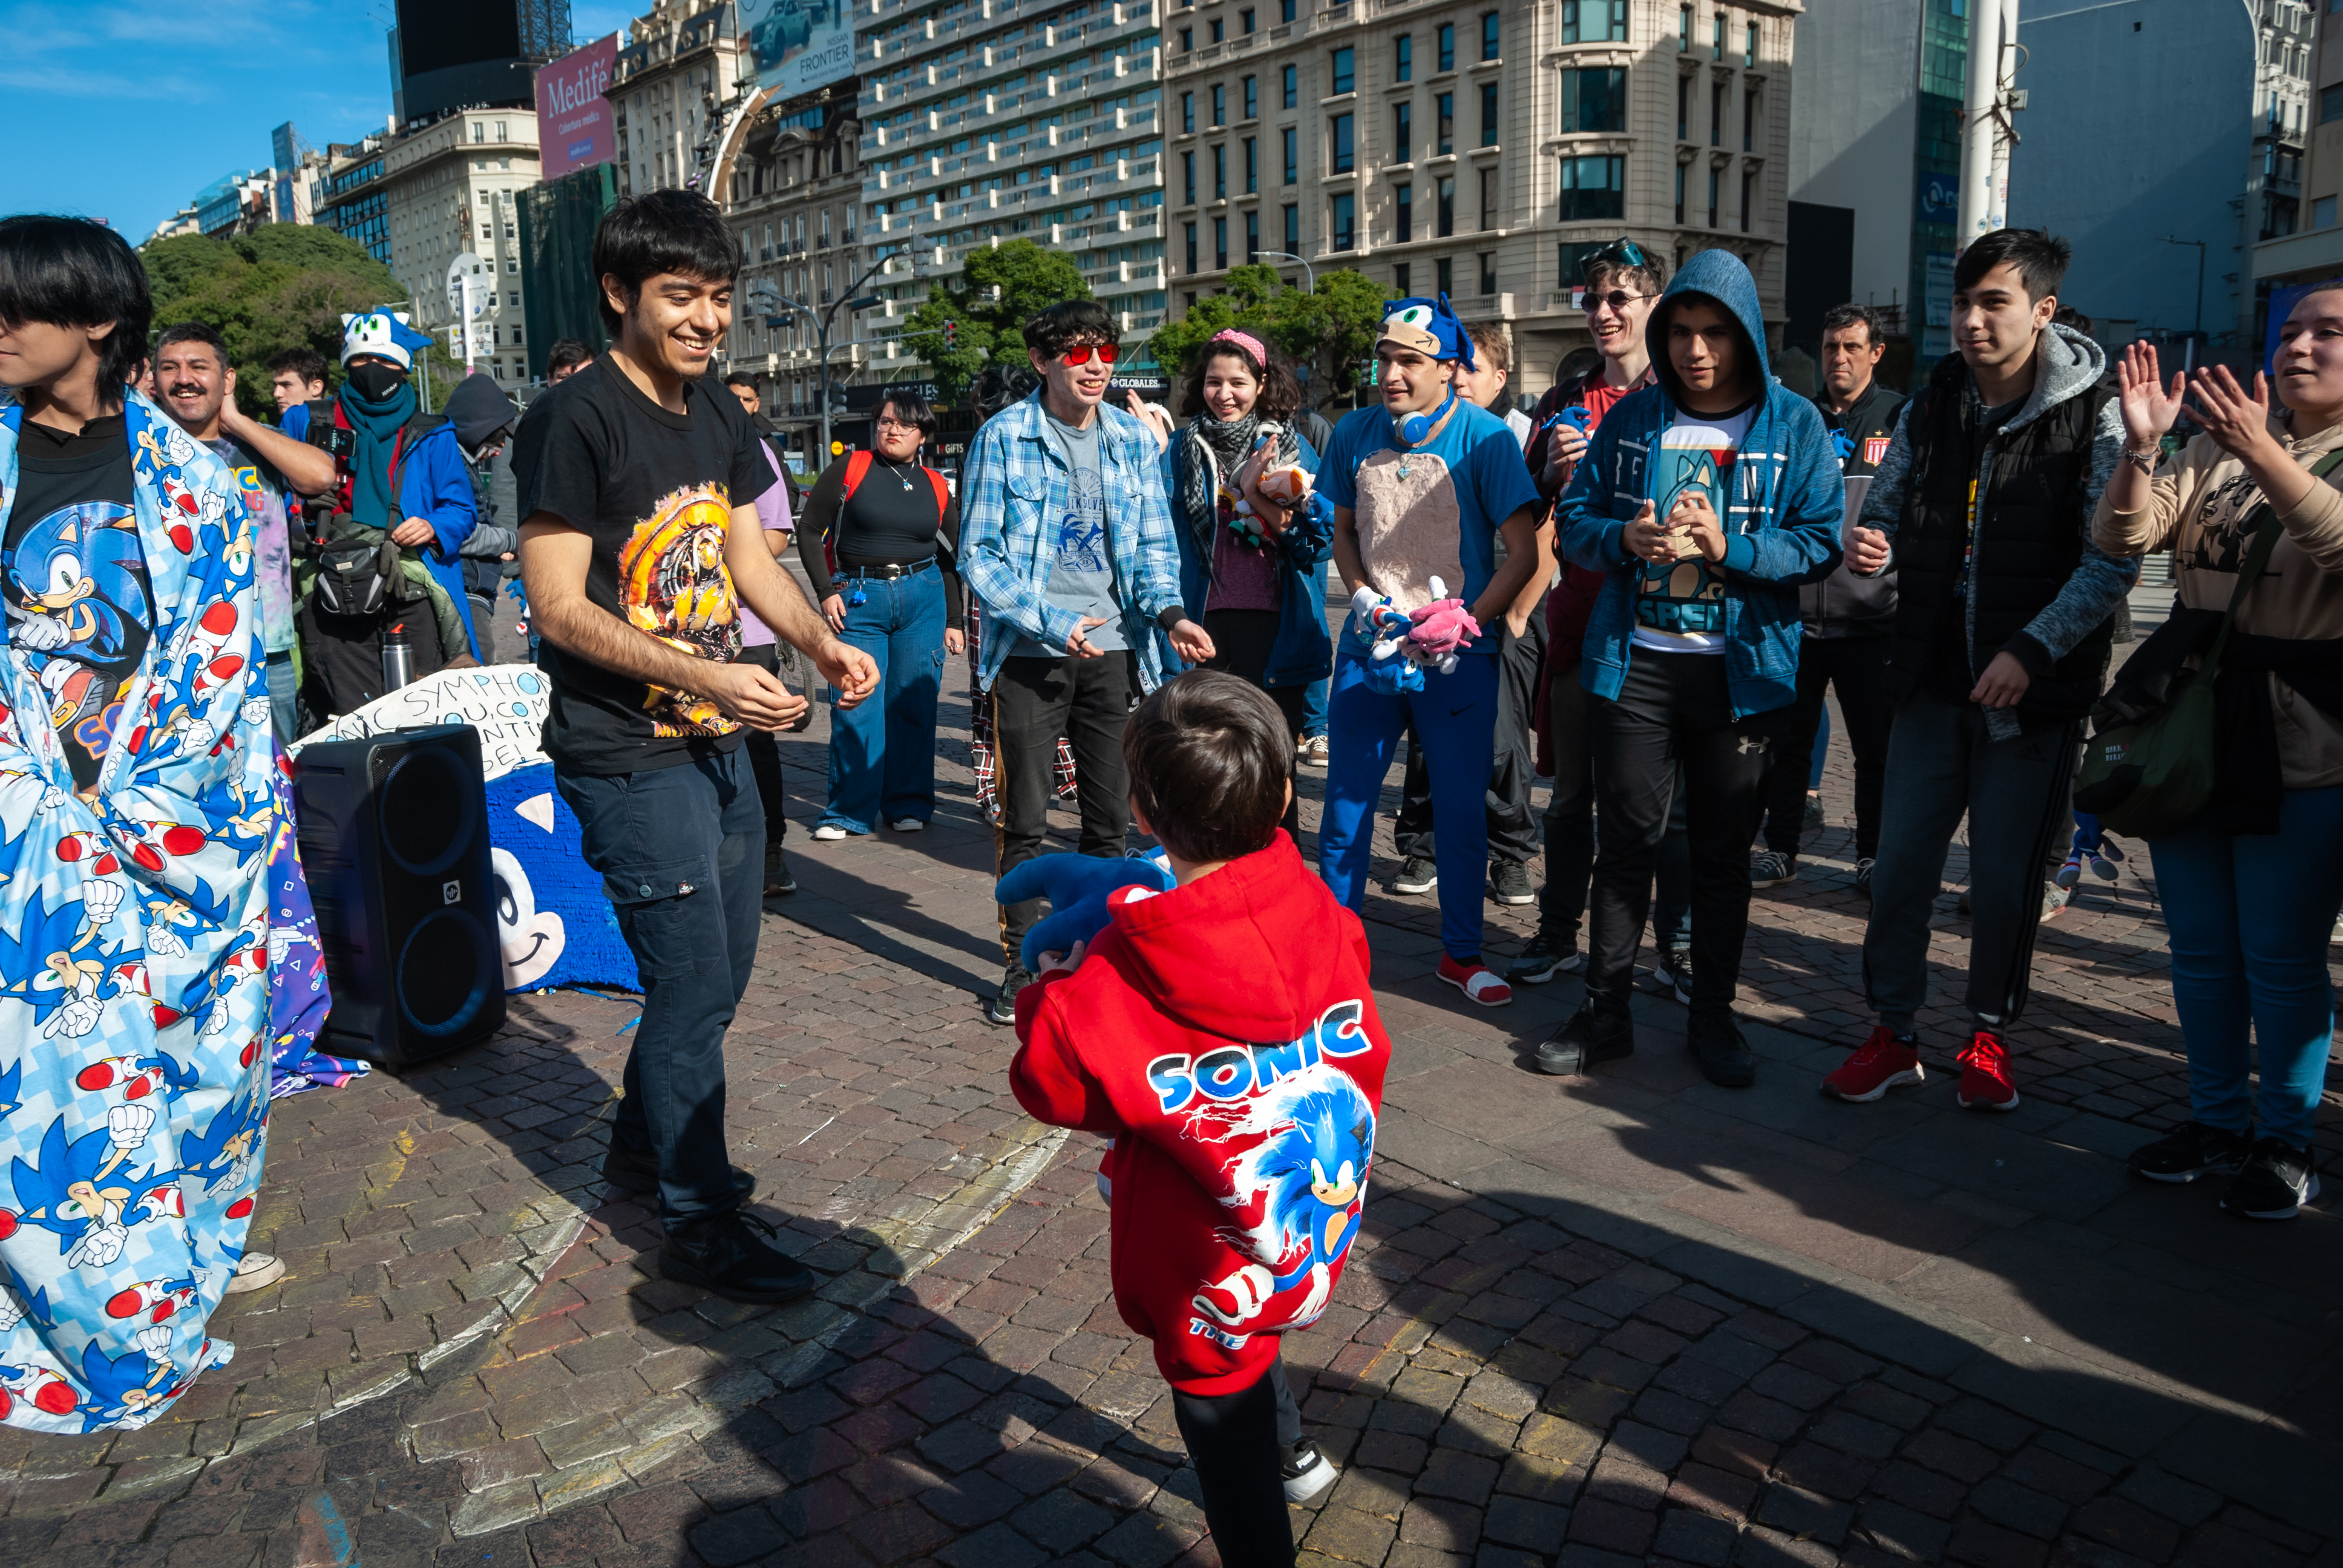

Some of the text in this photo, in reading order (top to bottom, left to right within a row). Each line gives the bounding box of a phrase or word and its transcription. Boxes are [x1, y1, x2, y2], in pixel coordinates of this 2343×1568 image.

[827, 32, 848, 47] NISSAN
[800, 44, 849, 74] FRONTIER
[548, 57, 608, 119] Medifé
[1146, 999, 1372, 1116] SONIC
[1189, 1317, 1251, 1350] THE
